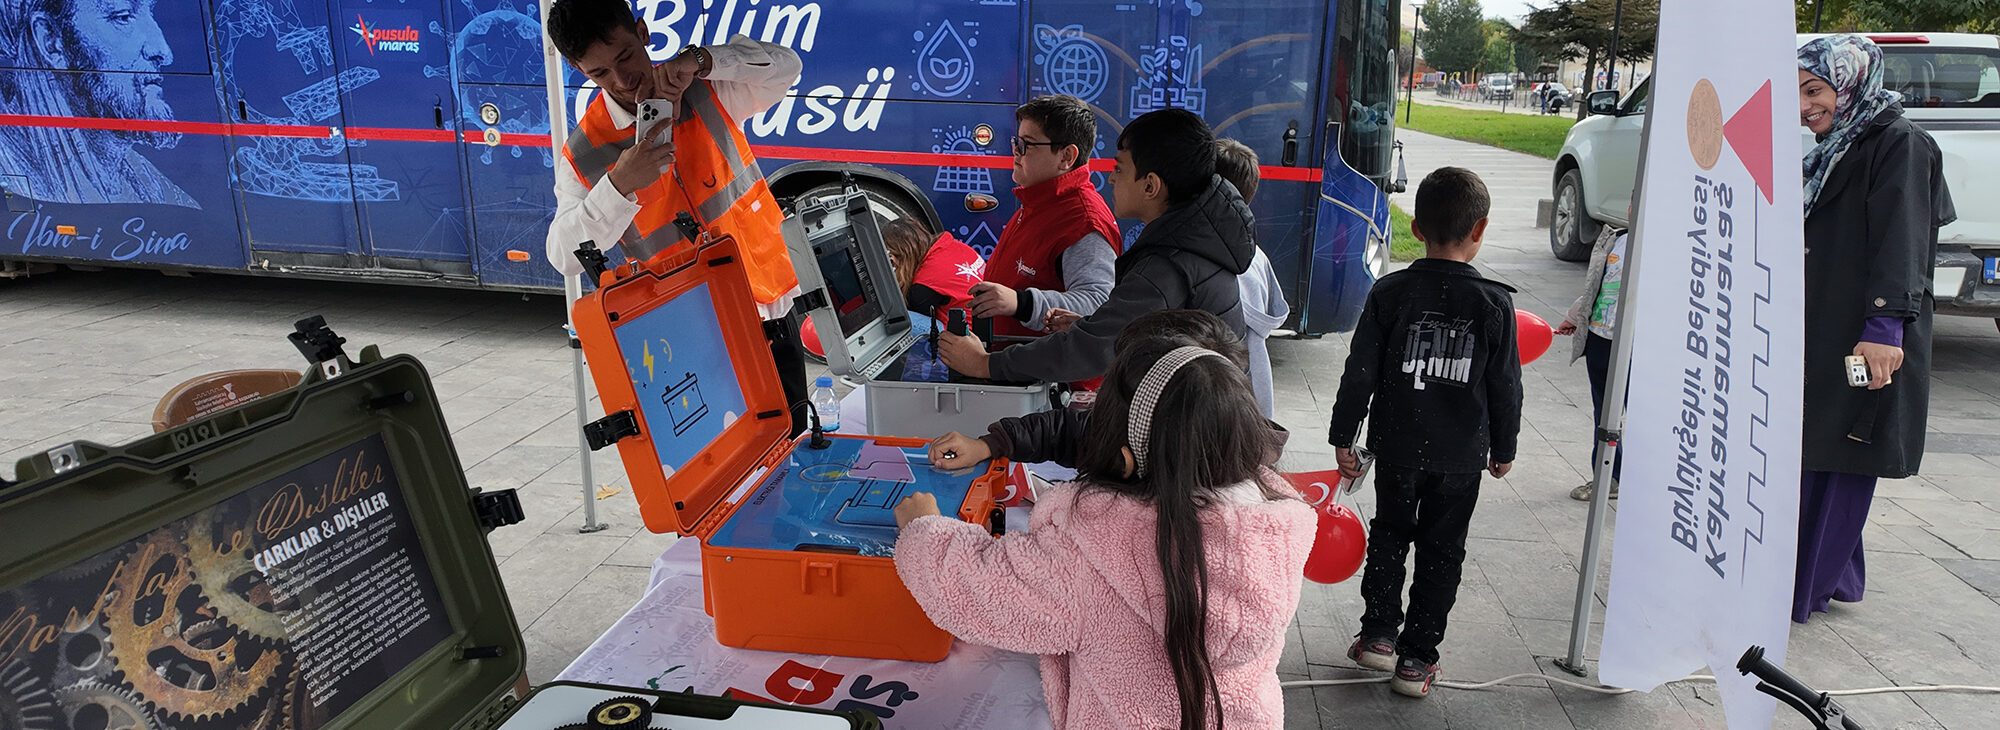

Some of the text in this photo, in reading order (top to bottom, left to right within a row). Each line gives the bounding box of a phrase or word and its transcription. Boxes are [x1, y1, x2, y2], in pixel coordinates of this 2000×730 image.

[372, 25, 419, 46] pusula
[379, 41, 420, 53] maraş
[637, 0, 821, 62] Bilim
[111, 216, 192, 261] Sina
[252, 492, 389, 577] ÇARKLAR & DİŞLİLER
[346, 528, 367, 543] sistemin
[368, 513, 393, 531] dönmesini
[330, 552, 343, 562] Sizce
[281, 608, 302, 625] Çarklar
[335, 581, 349, 592] basit
[351, 569, 369, 583] makine
[371, 552, 398, 571] örnekleridir
[284, 618, 305, 634] kuvvet
[312, 599, 338, 617] hareketin
[346, 580, 370, 596] noktadan
[369, 571, 384, 582] başka
[391, 556, 409, 569] noktaya
[312, 621, 338, 640] arasından
[338, 608, 359, 625] geçerek
[359, 591, 385, 611] birbirlerini
[320, 607, 344, 624] sağlayan
[299, 659, 312, 671] dişli
[314, 647, 332, 661] içinde
[362, 620, 375, 630] Kolu
[376, 597, 410, 622] çevirdiğimizde
[303, 598, 424, 681] çarklardan küçük olan daha büyük olana göre daha
[309, 634, 335, 653] içerisinde
[336, 628, 344, 636] bir
[344, 613, 369, 631] noktadan
[369, 603, 384, 617] geçen
[310, 676, 340, 698] arabaların
[351, 646, 383, 670] bisikletlerin
[385, 637, 397, 647] vites
[398, 614, 430, 638] sistemlerinde
[307, 678, 319, 690] çok
[320, 671, 329, 680] tur
[353, 642, 374, 658] Günlük
[374, 628, 395, 643] hayatta
